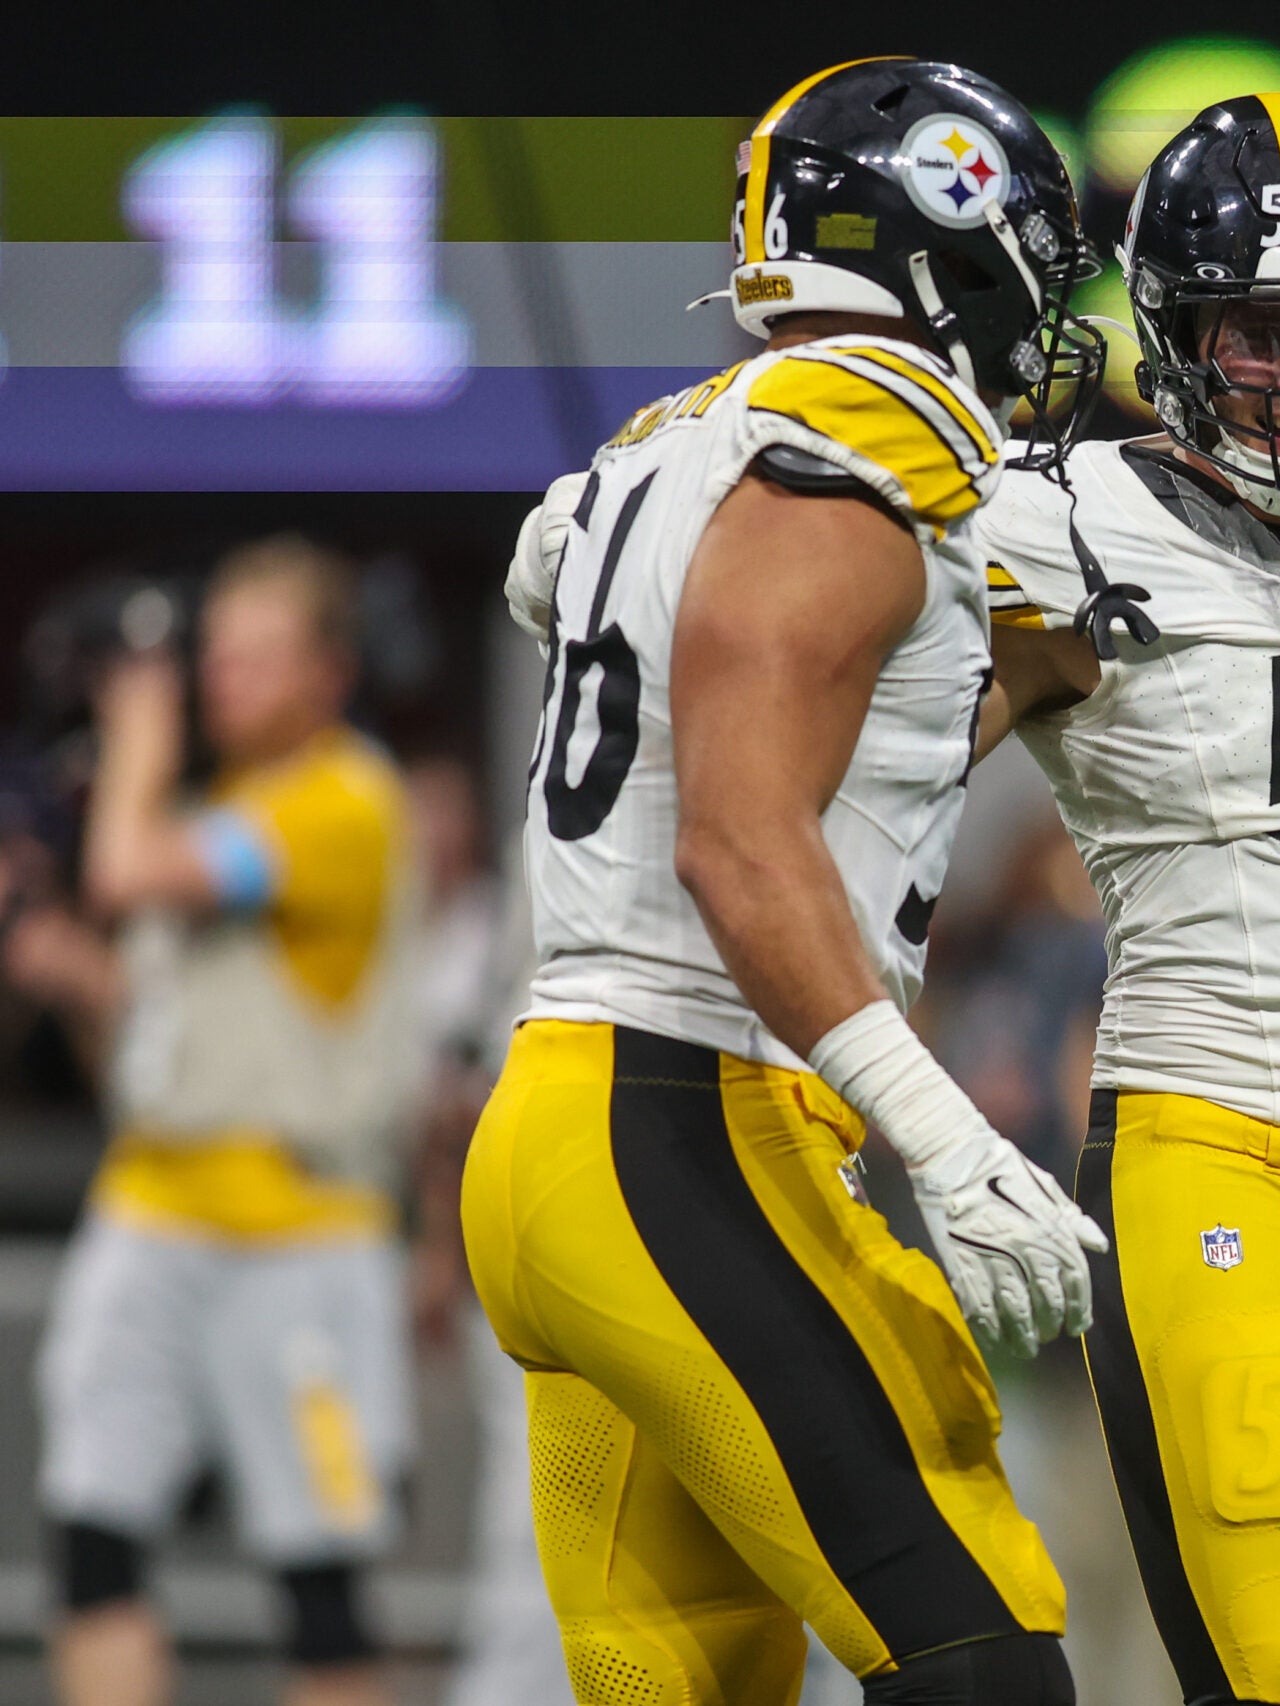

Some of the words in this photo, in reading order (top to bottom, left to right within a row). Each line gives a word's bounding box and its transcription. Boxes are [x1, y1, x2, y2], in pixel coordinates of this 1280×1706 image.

[916, 156, 954, 171] Steelers
[735, 192, 789, 265] 56
[118, 104, 475, 410] 11
[1210, 1244, 1238, 1262] NFL
